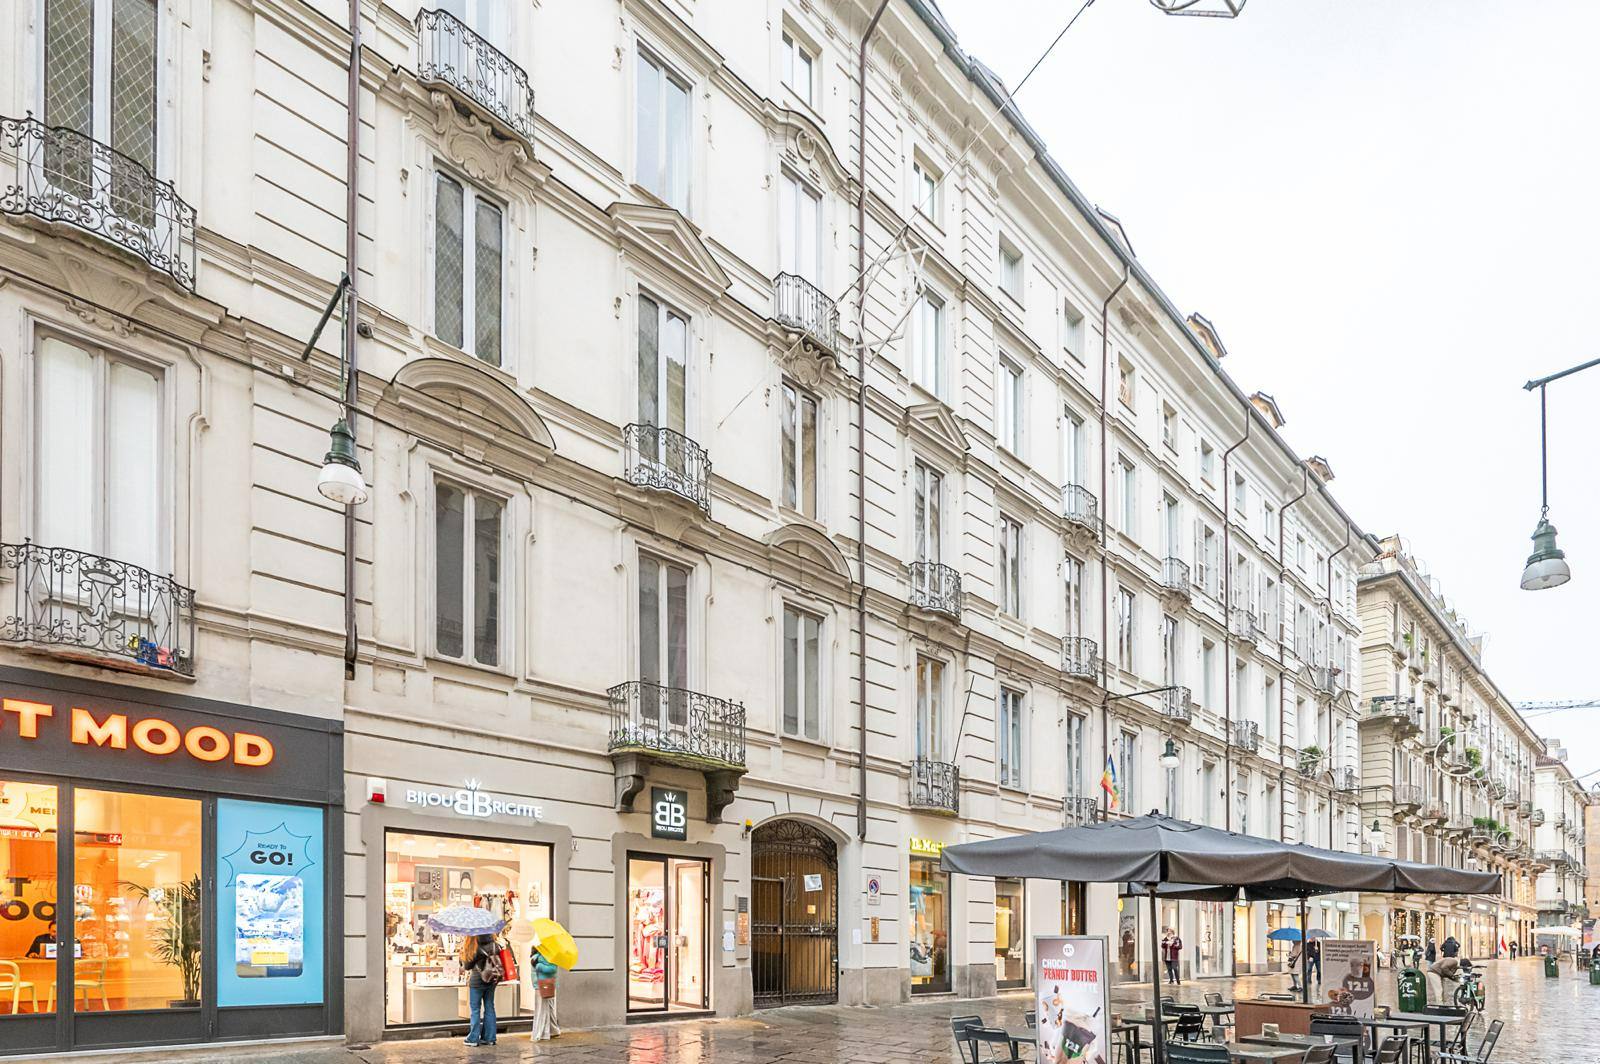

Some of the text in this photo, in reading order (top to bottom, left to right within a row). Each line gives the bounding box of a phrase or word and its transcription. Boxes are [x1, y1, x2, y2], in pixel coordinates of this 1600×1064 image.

[71, 708, 274, 766] MOOD
[406, 789, 454, 807] BIJOU
[250, 850, 293, 866] GO!
[1042, 959, 1067, 968] CHOCO
[1044, 968, 1098, 982] PEANUT BUTTER
